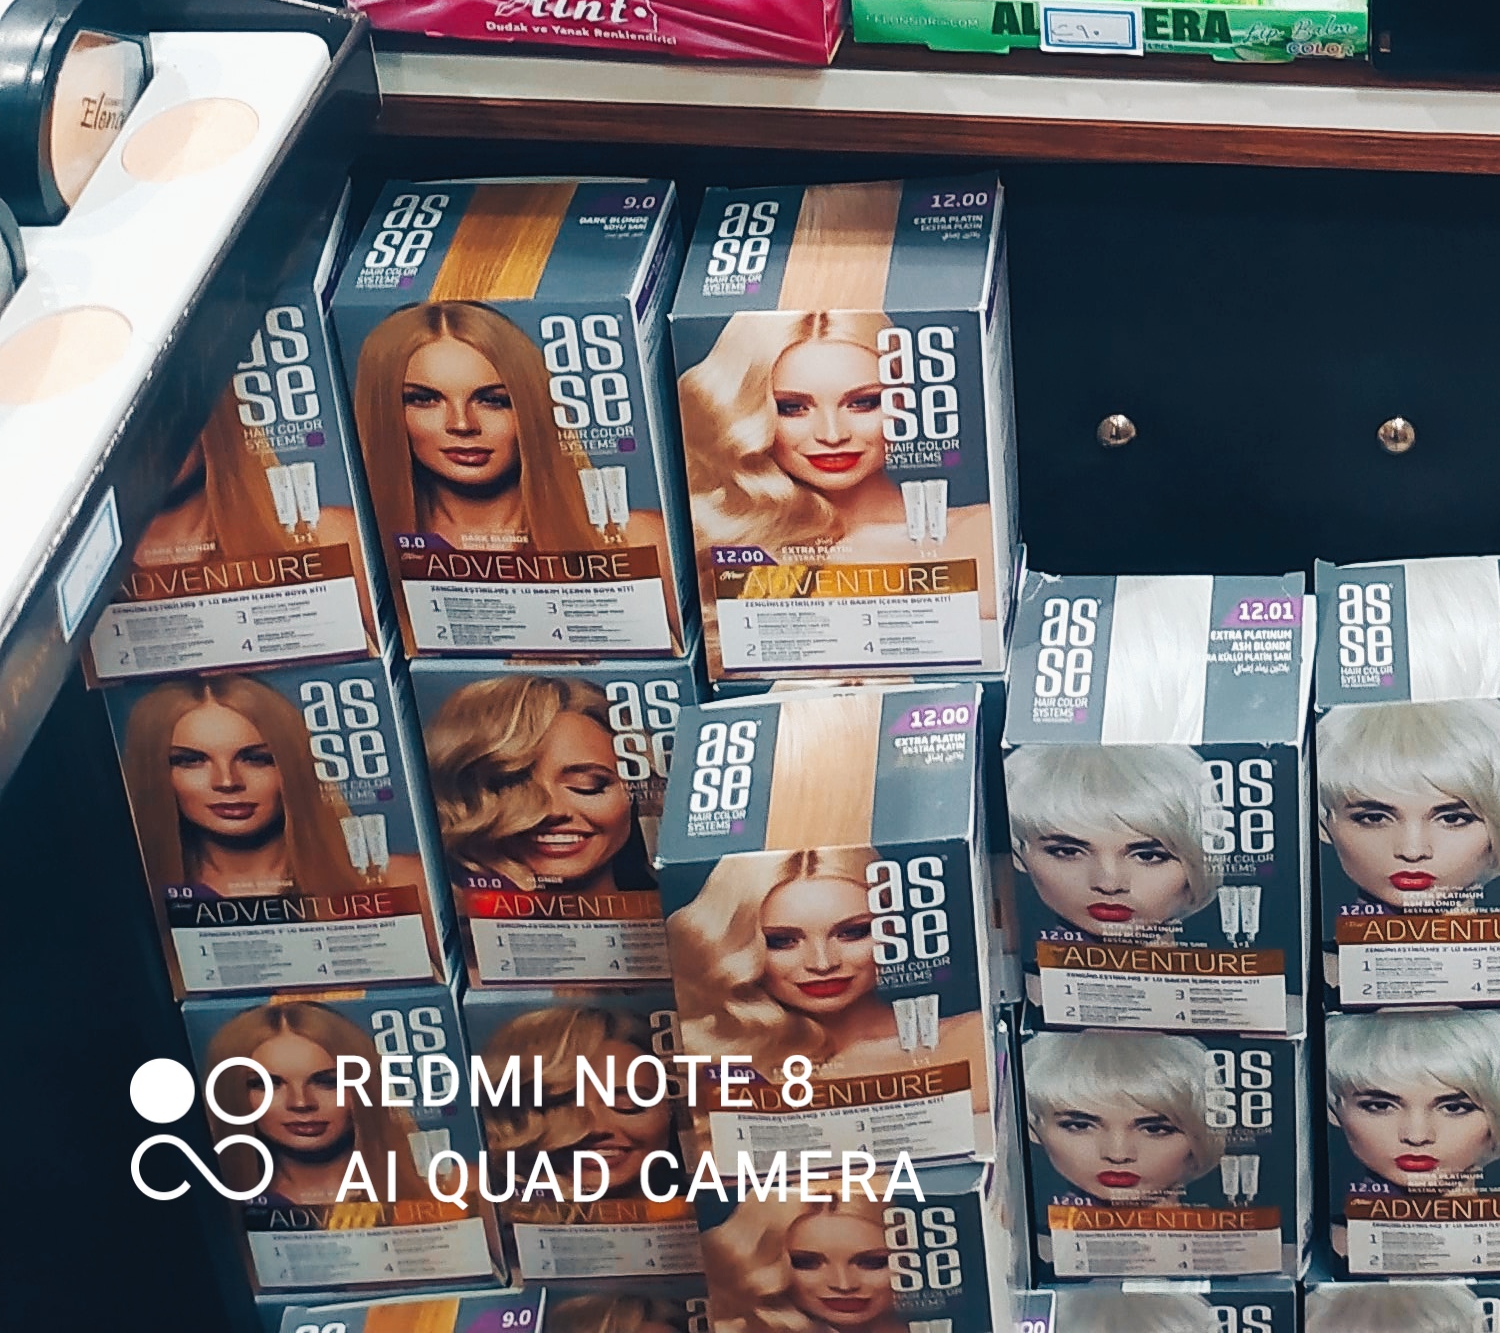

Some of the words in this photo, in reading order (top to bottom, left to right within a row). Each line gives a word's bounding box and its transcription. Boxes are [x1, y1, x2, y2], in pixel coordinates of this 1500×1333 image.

[1144, 8, 1232, 44] ERA
[623, 194, 657, 211] 9.0
[930, 192, 989, 208] 12.00
[541, 314, 623, 372] as
[878, 326, 957, 385] as
[549, 373, 632, 428] se
[881, 385, 960, 443] se
[591, 425, 635, 439] COLOR
[885, 442, 915, 453] HAIR
[918, 439, 961, 452] COLOR
[426, 552, 632, 581] ADVENTURE
[716, 550, 764, 564] 12.00
[743, 565, 950, 596] ADVENTURE
[1041, 598, 1100, 647] as
[1239, 601, 1294, 621] 12.01
[1244, 629, 1293, 640] PLATINUM
[1036, 647, 1094, 698] se
[911, 706, 970, 728] 12.00
[195, 887, 395, 924] ADVENTURE
[1340, 905, 1385, 916] 12.01
[1039, 931, 1085, 942] 12.01
[1063, 949, 1258, 976] ADVENTURE
